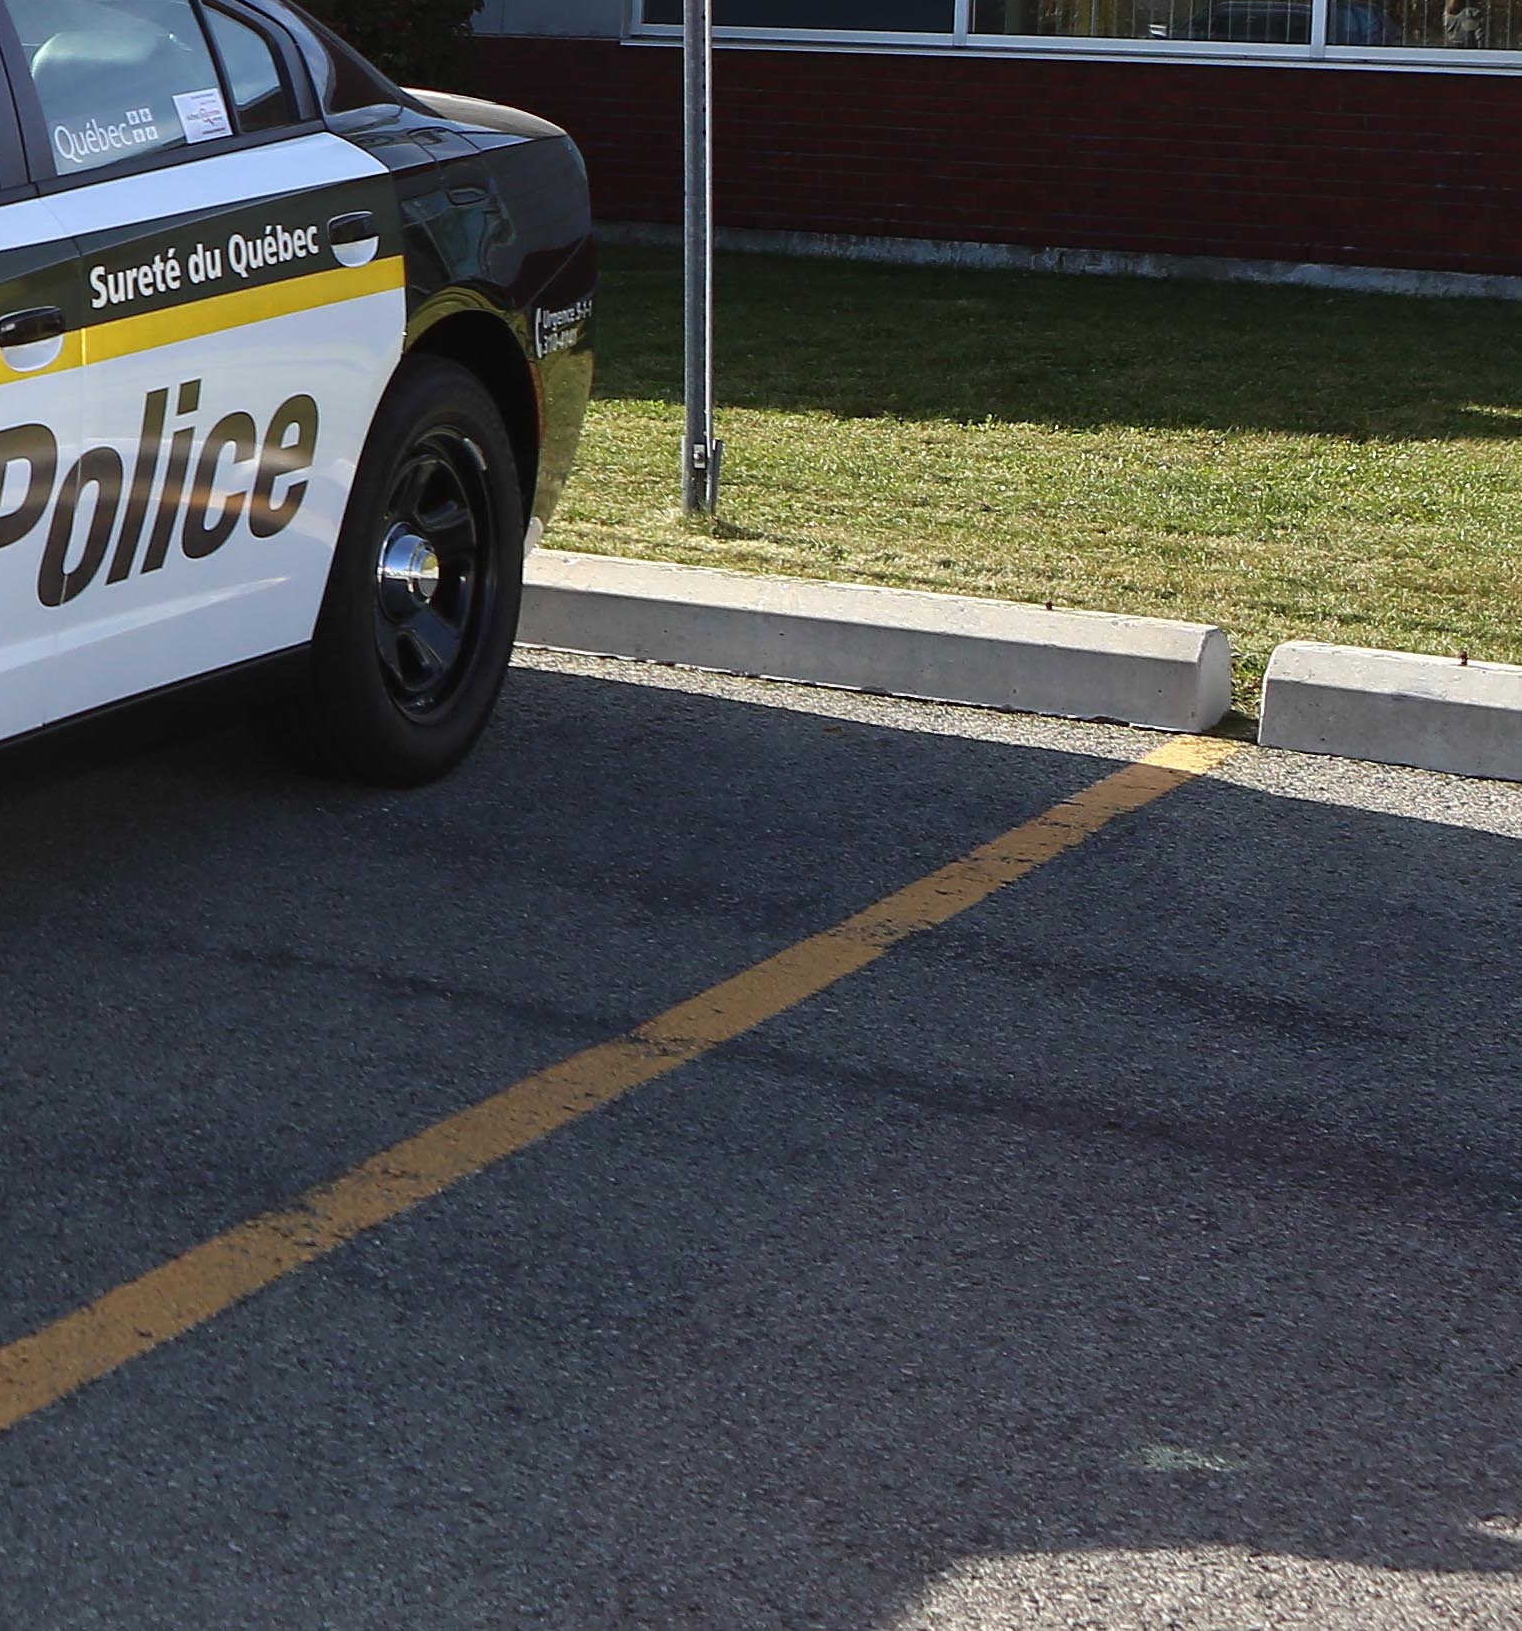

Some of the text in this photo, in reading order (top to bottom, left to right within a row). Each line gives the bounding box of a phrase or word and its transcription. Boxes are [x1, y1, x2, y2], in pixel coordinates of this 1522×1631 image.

[54, 118, 133, 163] Québec
[89, 224, 319, 309] Sureté du Québec
